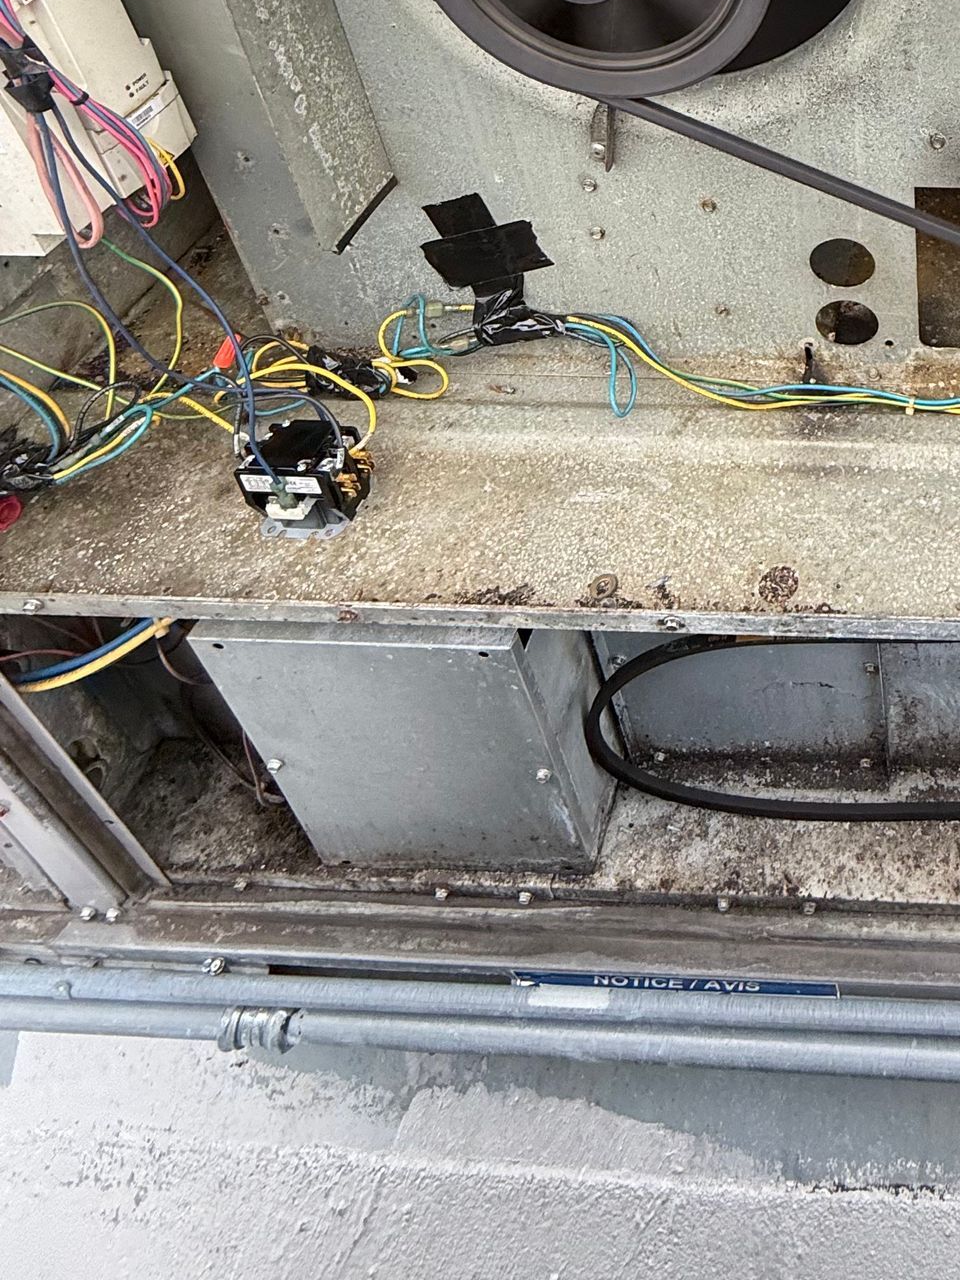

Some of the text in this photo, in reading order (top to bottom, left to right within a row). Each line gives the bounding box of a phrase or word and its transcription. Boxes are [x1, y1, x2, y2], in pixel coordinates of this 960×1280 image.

[593, 975, 760, 992] NOTICE / AVIS
